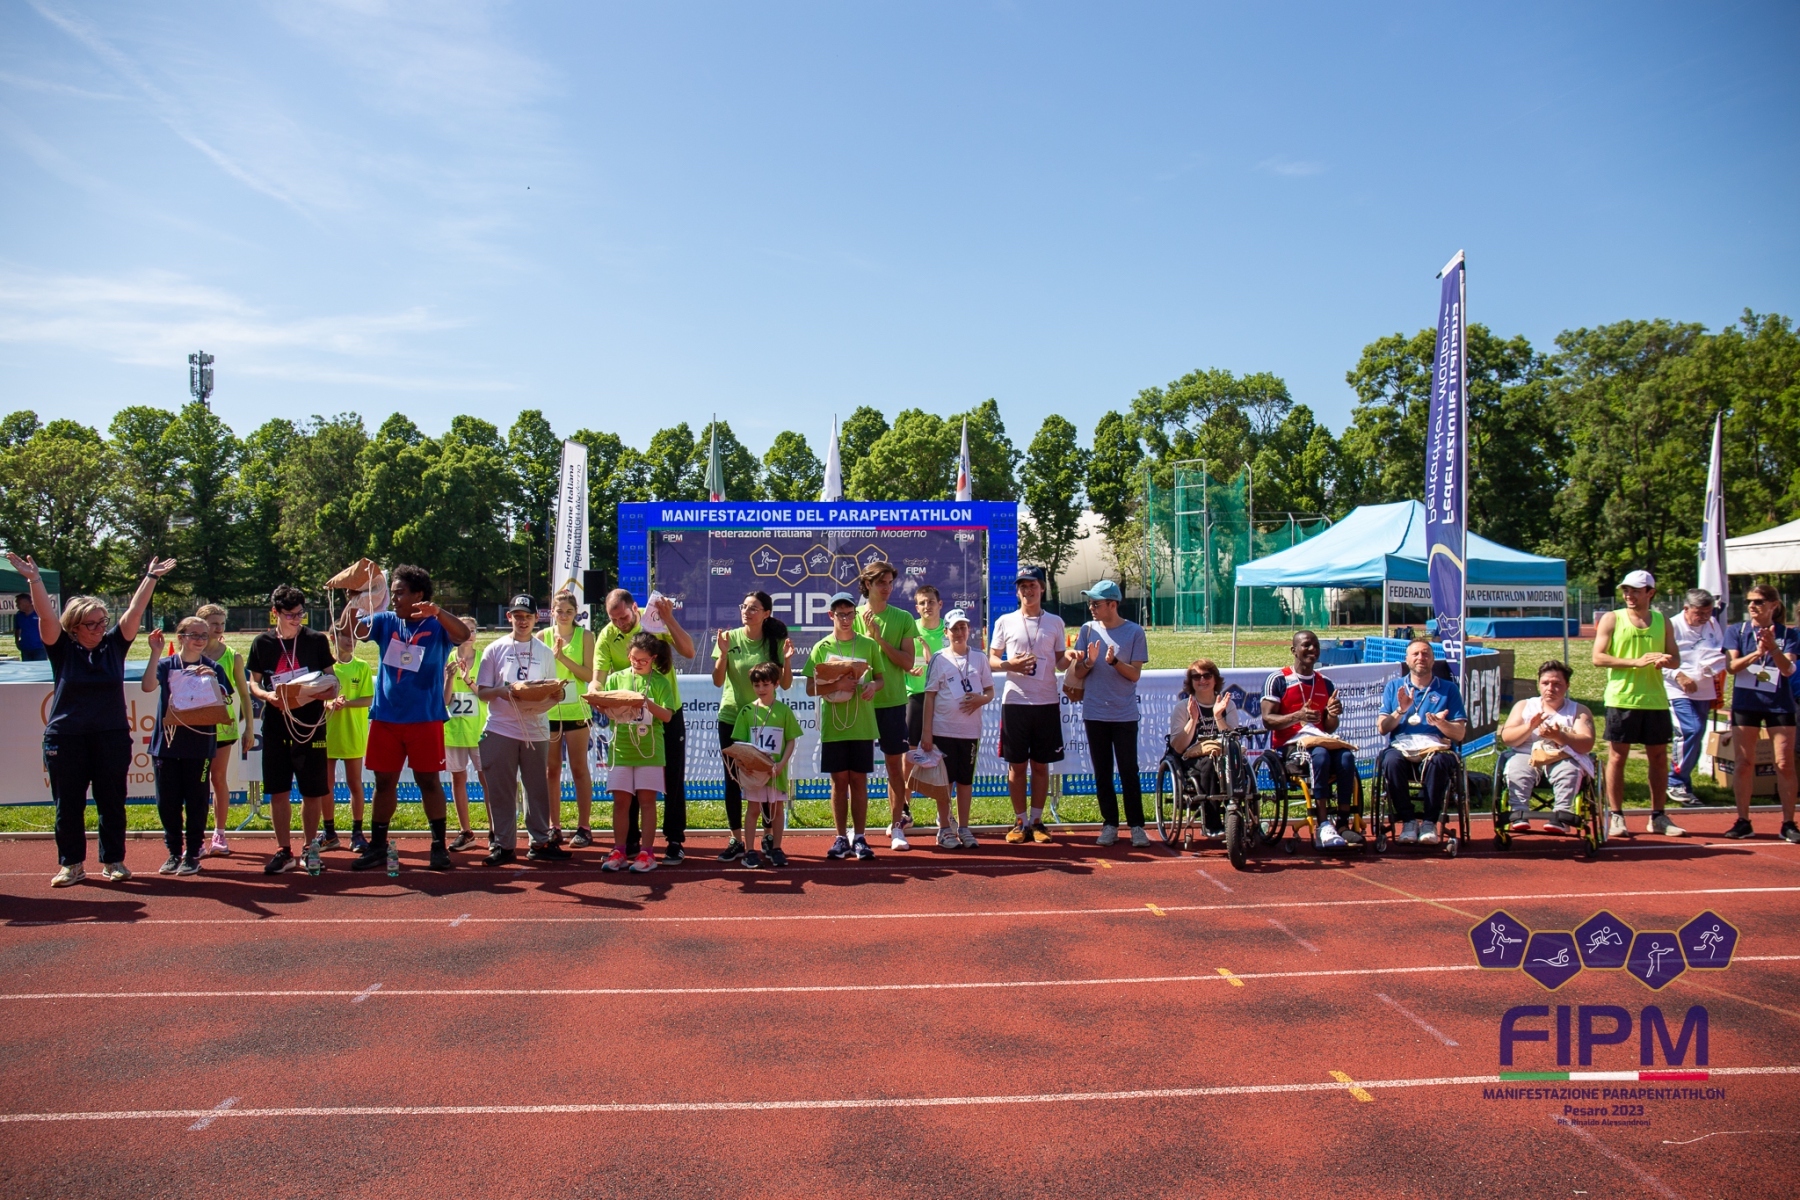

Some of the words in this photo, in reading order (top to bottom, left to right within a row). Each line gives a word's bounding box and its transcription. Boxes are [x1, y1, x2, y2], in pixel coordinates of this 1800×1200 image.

[567, 465, 575, 502] Italiana
[662, 509, 792, 522] MANIFESTAZIONE
[796, 509, 824, 522] DEL
[829, 508, 972, 522] PARAPENTATHLON
[564, 506, 574, 570] Federazione
[708, 529, 772, 538] Federazione
[774, 530, 813, 538] Italiana
[821, 529, 878, 538] Pentathlon
[881, 529, 928, 538] Moderno
[954, 533, 975, 541] FIPM
[711, 567, 732, 575] FIPM
[905, 566, 926, 574] FIPM
[1389, 585, 1432, 599] FEDERAZIO
[1477, 589, 1525, 602] PENTATHLON
[1526, 590, 1564, 602] MODERNO
[0, 599, 15, 610] LON
[954, 600, 975, 608] FIPM
[452, 699, 474, 714] 22
[682, 698, 720, 712] edera
[760, 734, 777, 750] 14
